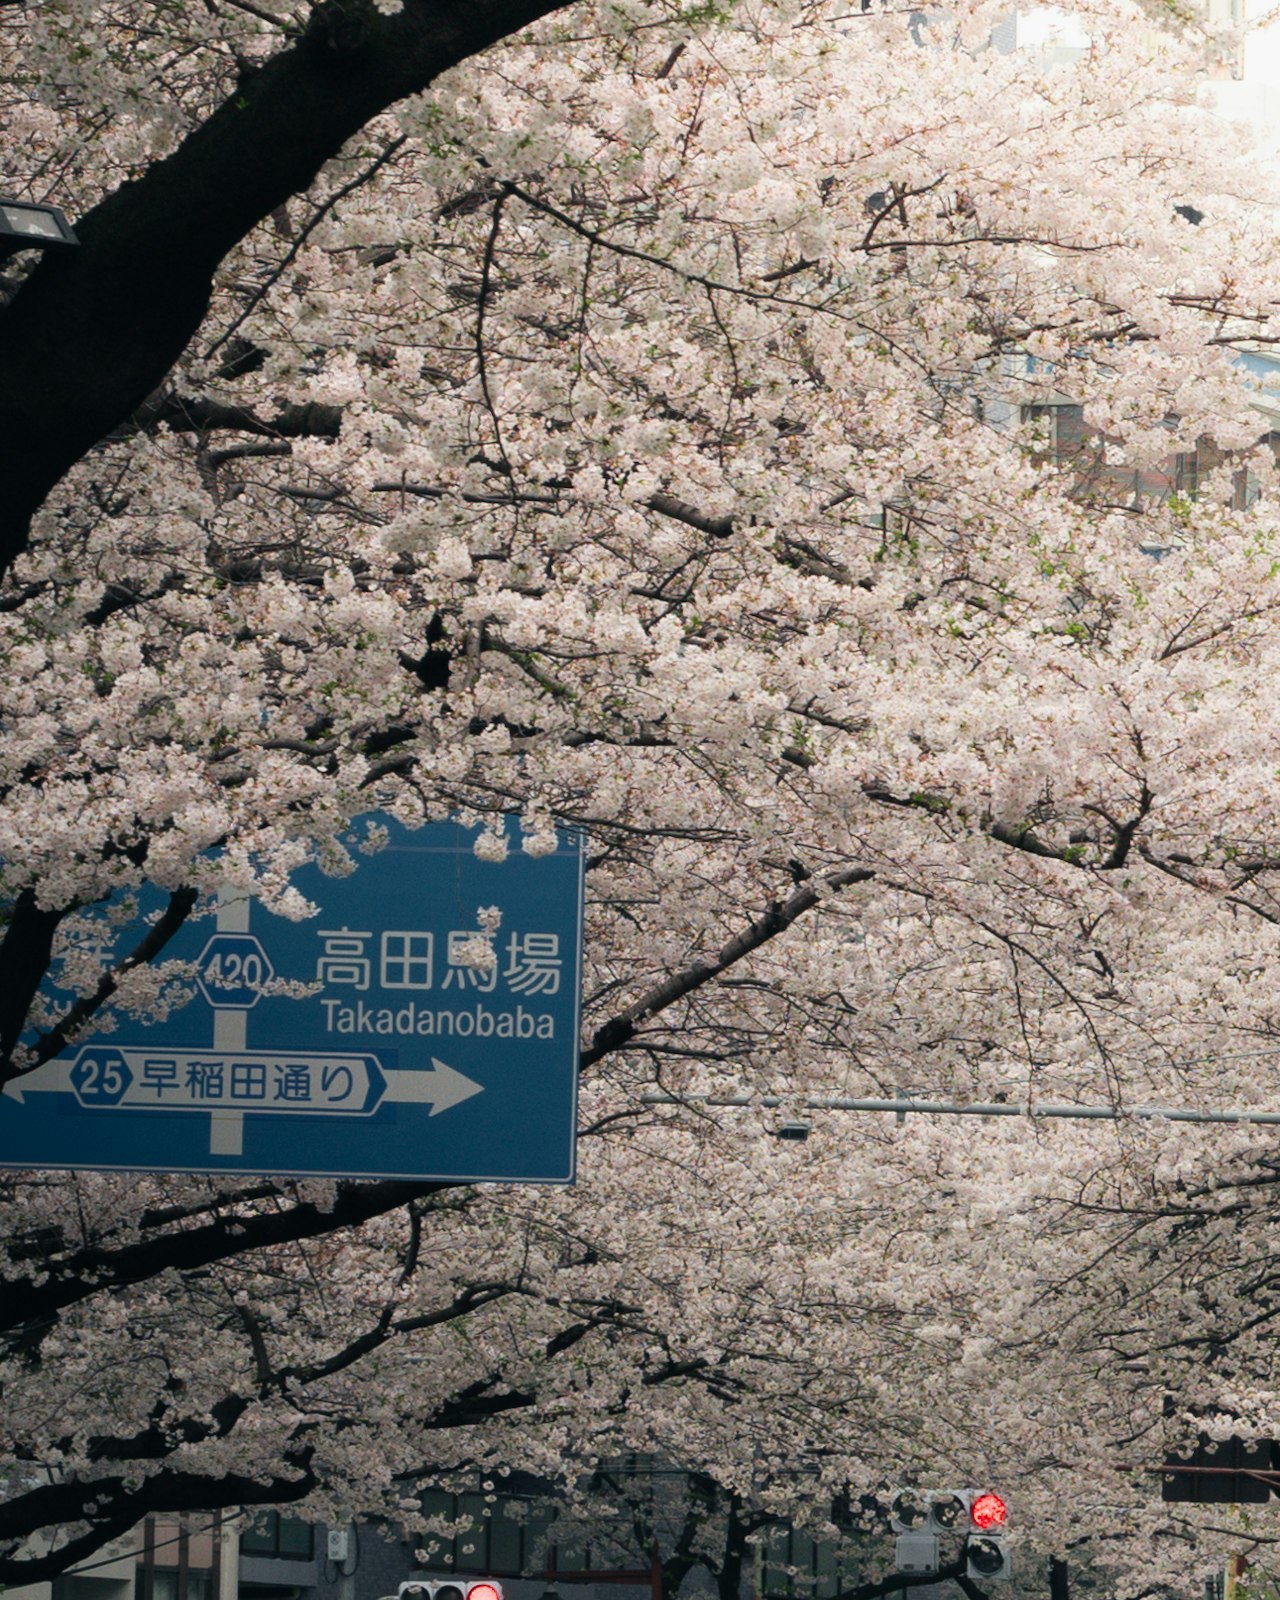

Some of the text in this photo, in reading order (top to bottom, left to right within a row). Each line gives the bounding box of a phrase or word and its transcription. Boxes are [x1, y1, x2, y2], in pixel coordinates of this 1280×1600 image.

[315, 926, 563, 996] 高田馬場
[320, 999, 555, 1040] Takadanobaba
[79, 1059, 355, 1103] 25 早稲田通り
